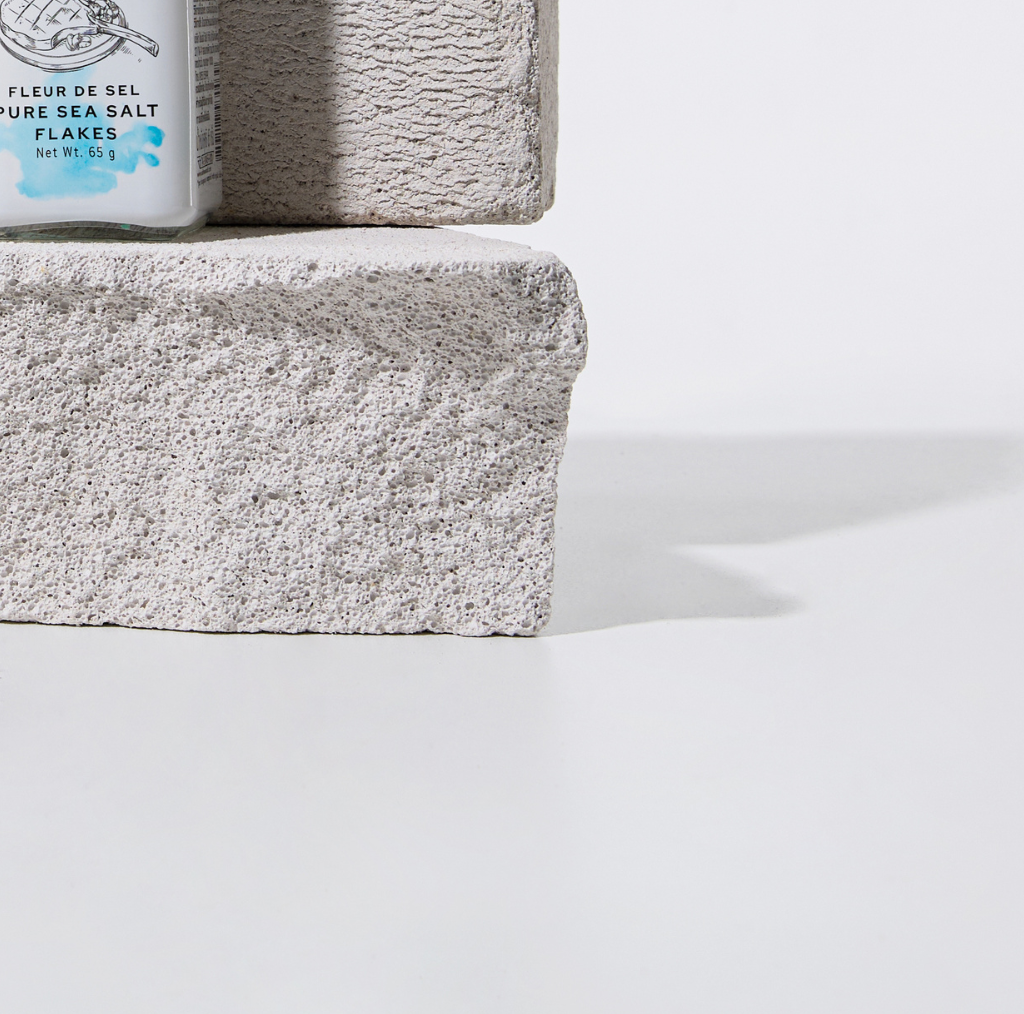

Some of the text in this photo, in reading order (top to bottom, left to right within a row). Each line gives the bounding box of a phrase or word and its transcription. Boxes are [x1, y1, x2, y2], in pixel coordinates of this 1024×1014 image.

[8, 84, 140, 98] FLEUR DE SEL
[57, 105, 98, 118] SEA
[106, 103, 159, 118] SALT
[35, 127, 117, 141] FLAKES
[36, 145, 115, 161] Net Wt. 65 g
